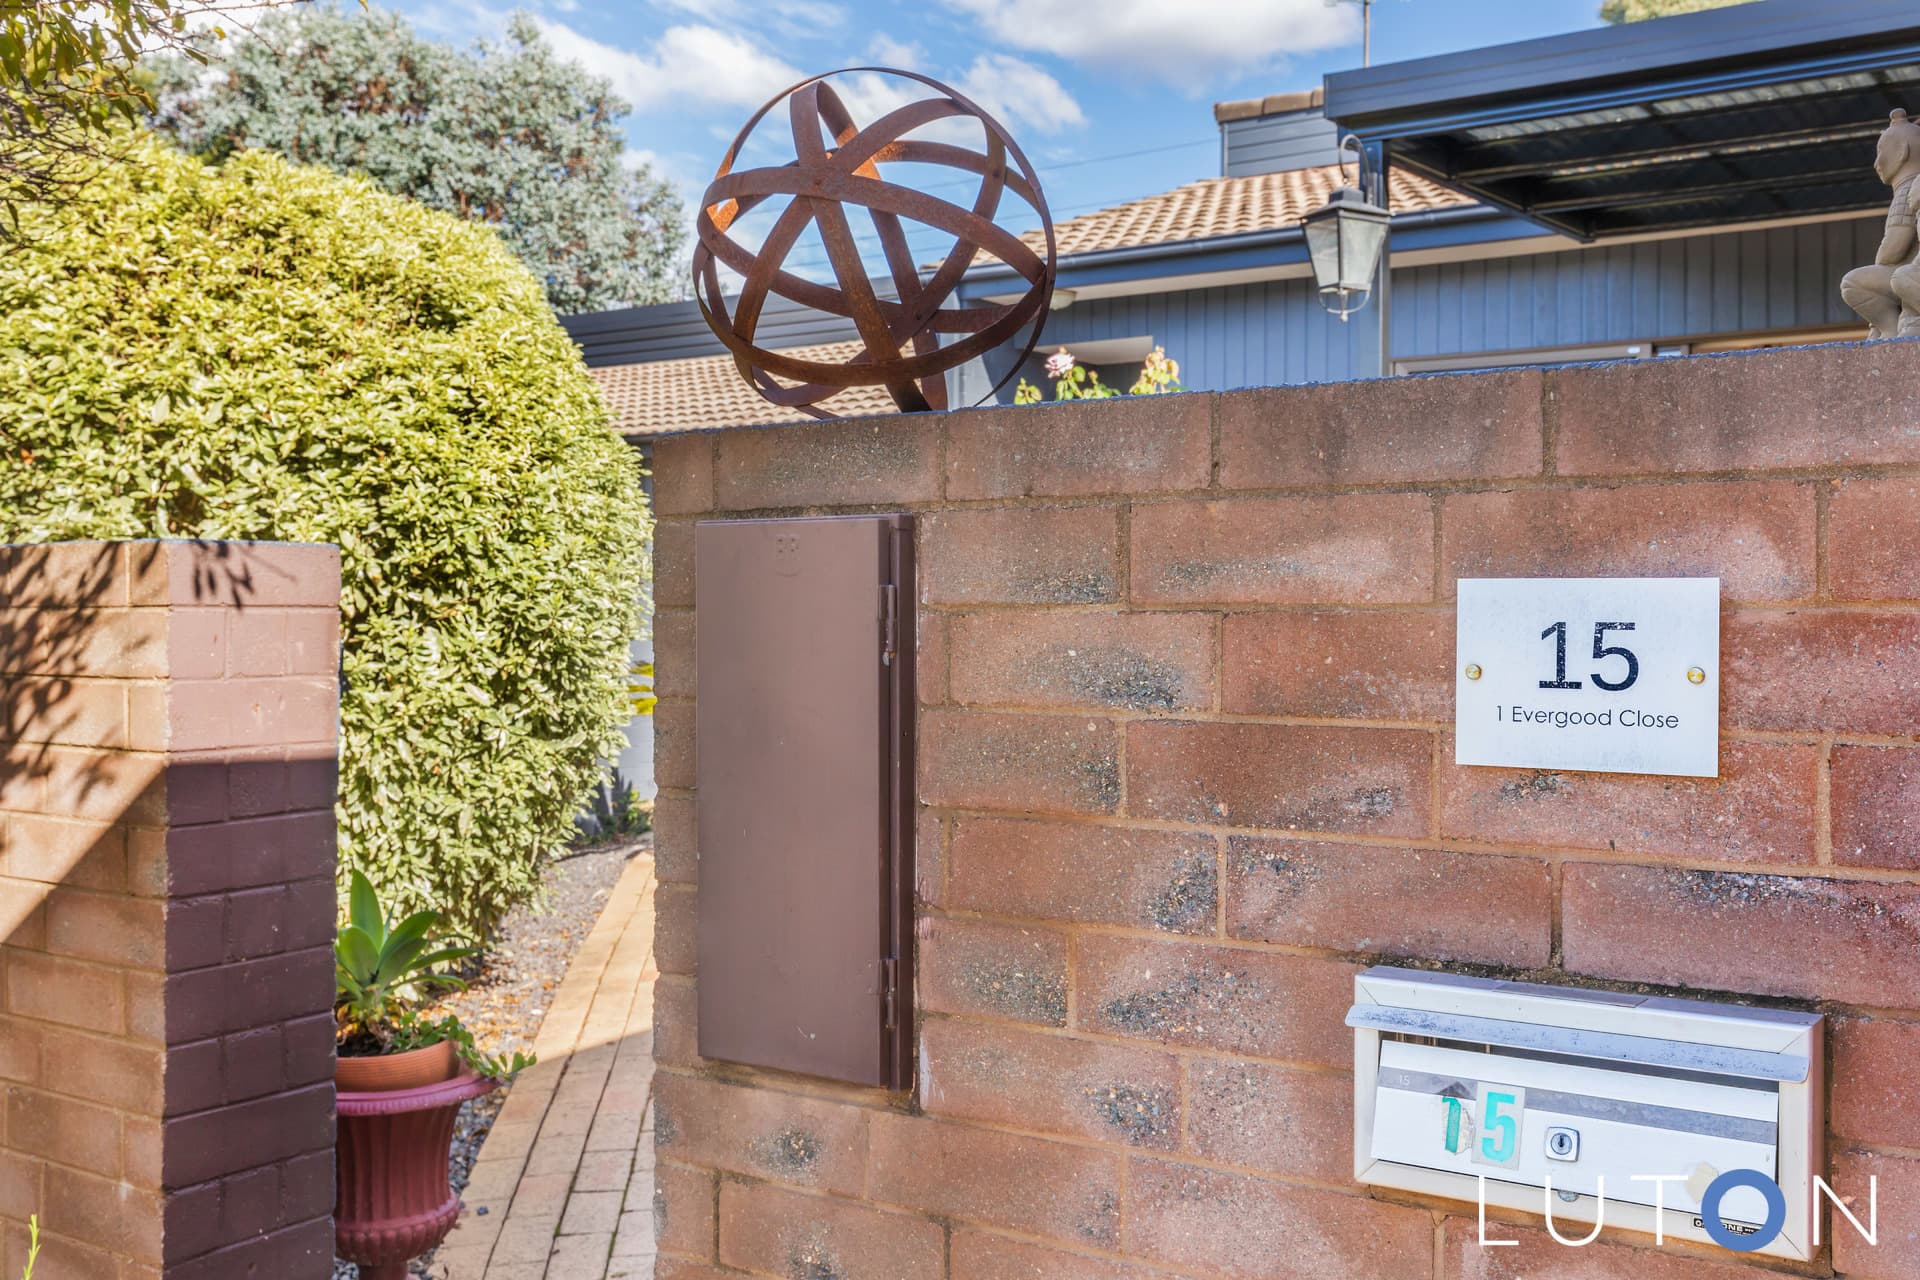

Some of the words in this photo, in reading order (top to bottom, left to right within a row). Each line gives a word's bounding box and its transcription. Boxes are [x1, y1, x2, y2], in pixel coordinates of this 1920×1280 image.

[1538, 621, 1639, 692] 15
[1496, 705, 1502, 722] 1
[1511, 705, 1612, 729] Evergood
[1619, 709, 1680, 729] Close
[1441, 1090, 1517, 1163] 15
